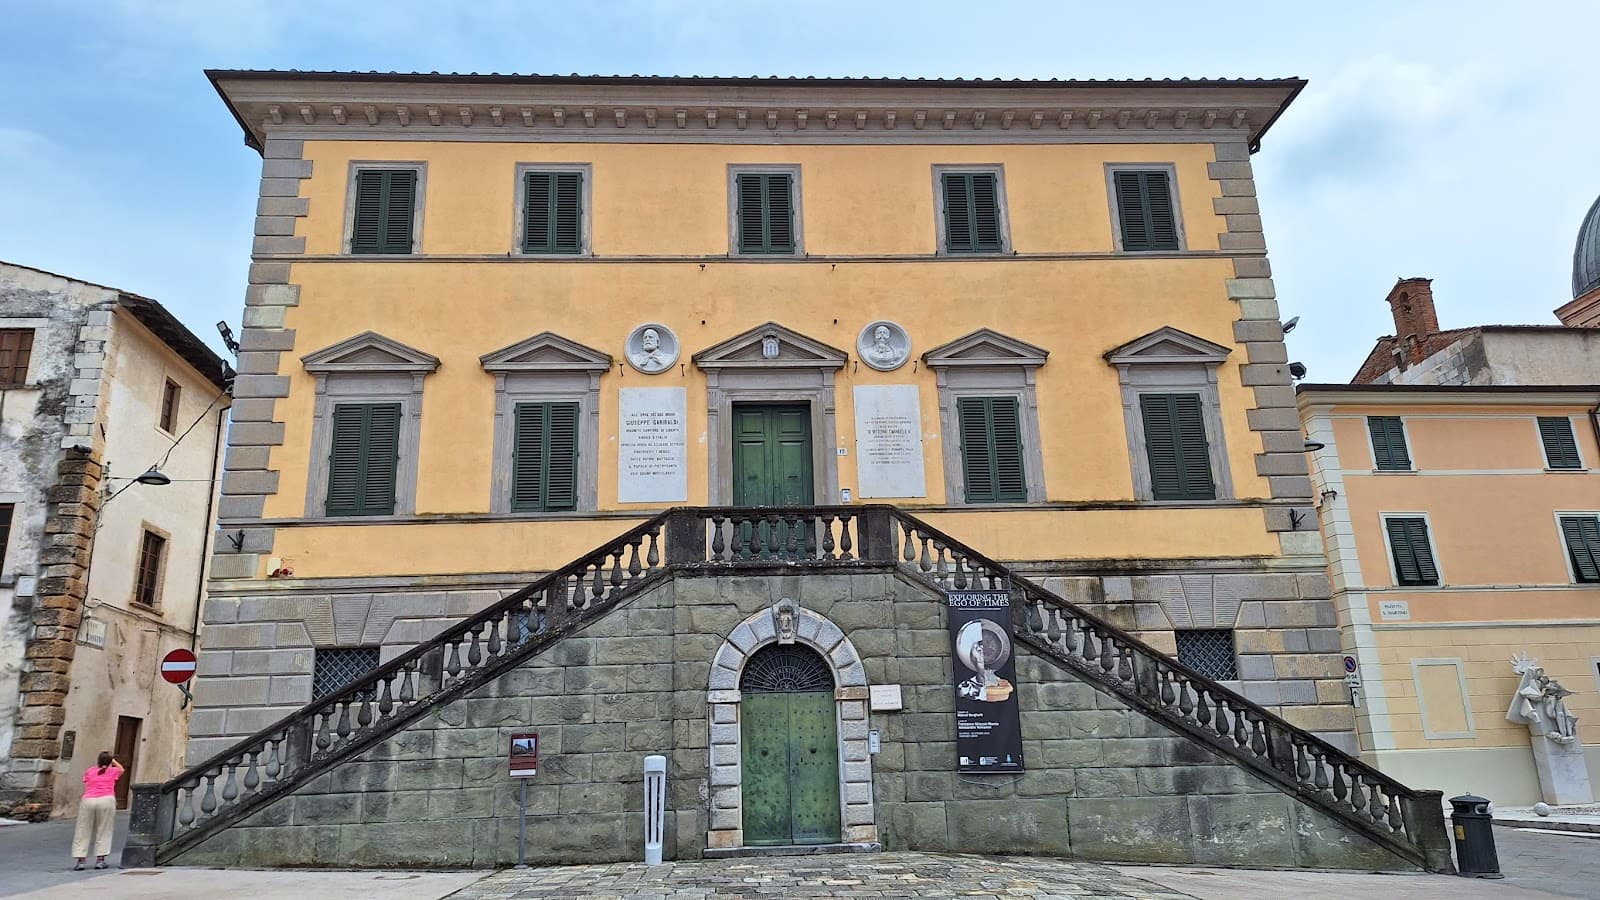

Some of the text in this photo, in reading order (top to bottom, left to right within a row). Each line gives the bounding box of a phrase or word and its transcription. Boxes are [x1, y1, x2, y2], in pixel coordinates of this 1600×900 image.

[653, 418, 679, 426] GARIBALDI
[948, 593, 1009, 601] EXPLORING THE
[949, 599, 1010, 607] EGO OF TIMES
